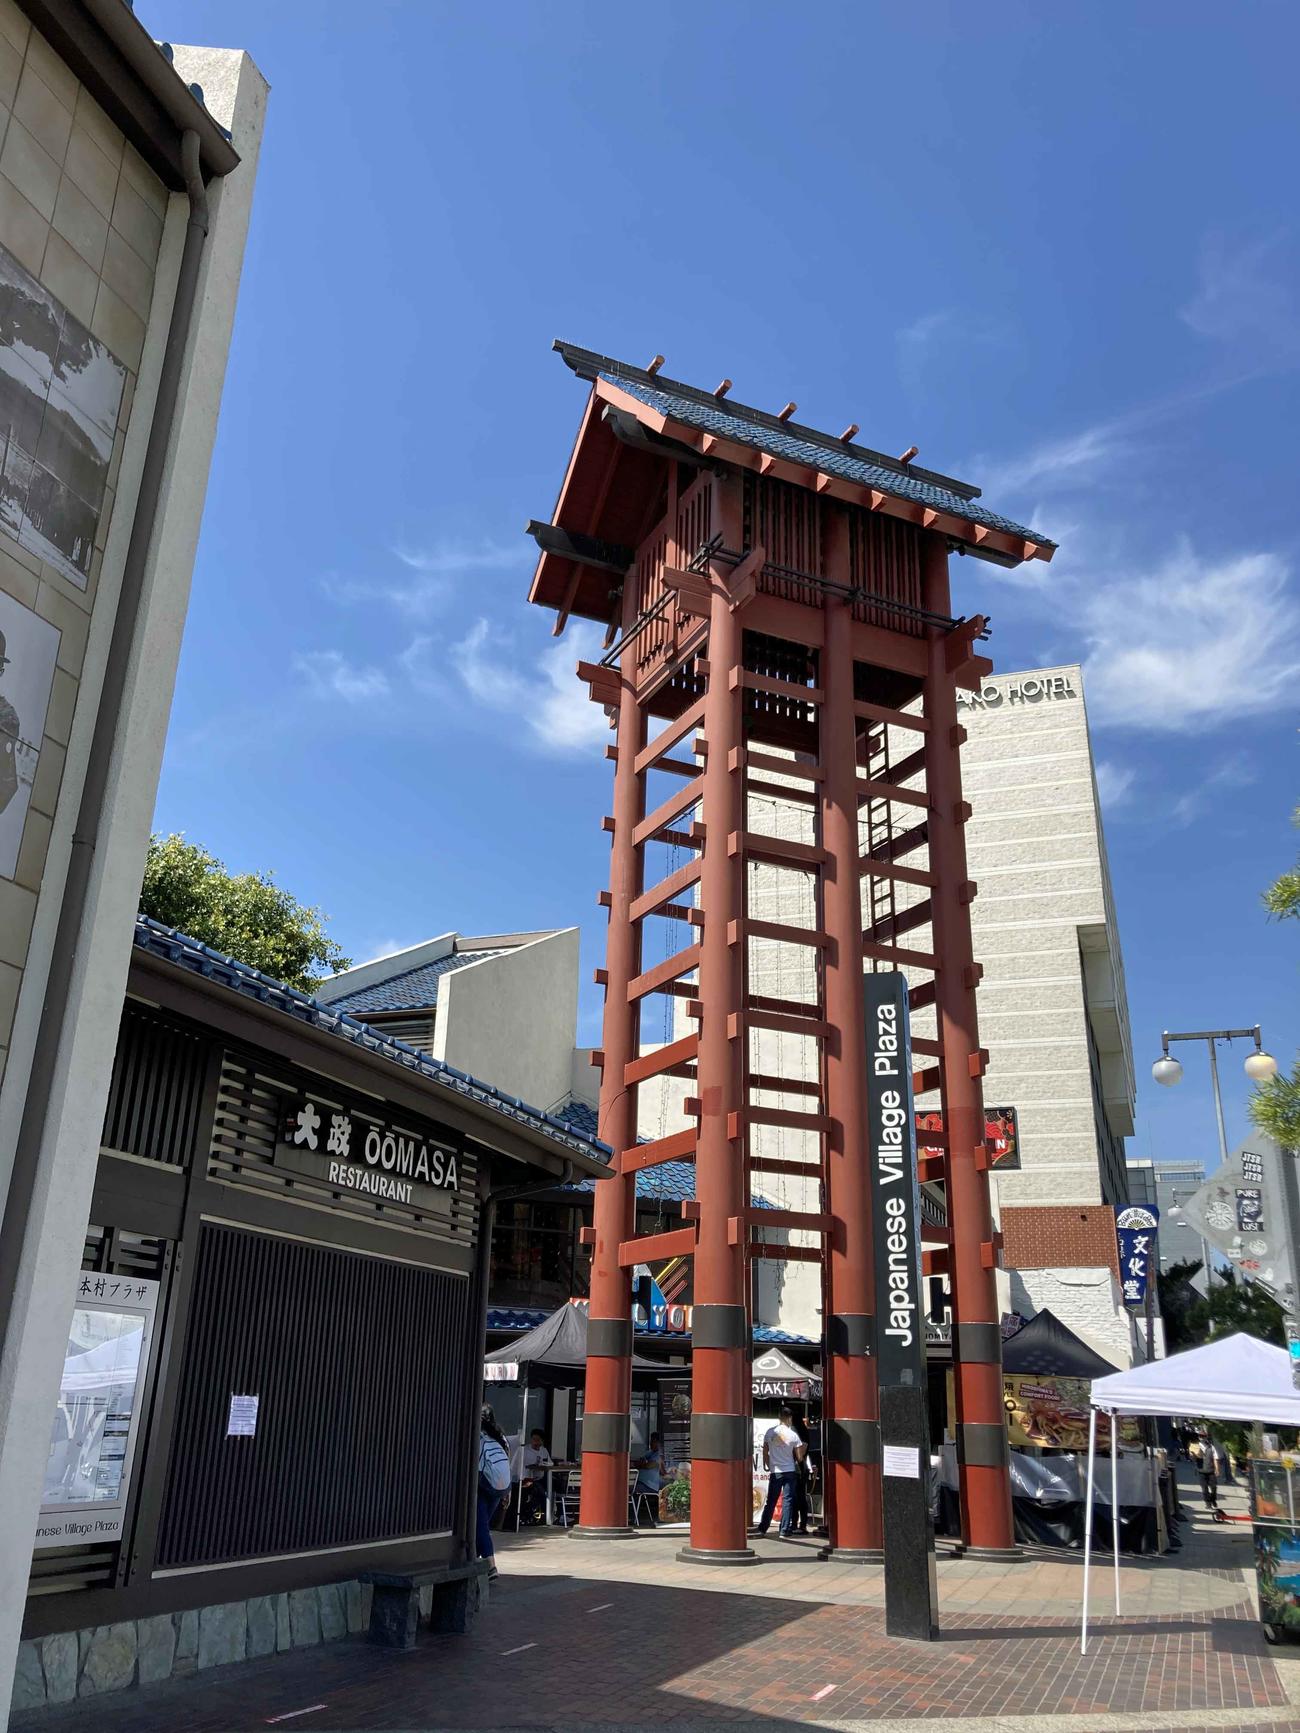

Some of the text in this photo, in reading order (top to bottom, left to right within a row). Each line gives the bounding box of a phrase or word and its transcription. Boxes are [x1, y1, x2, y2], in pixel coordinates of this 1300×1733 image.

[1007, 676, 1074, 698] HOTEL
[329, 1161, 413, 1204] RESTAURANT
[874, 1003, 915, 1346] Japanese Village Plaza
[1123, 1235, 1150, 1300] 文化堂
[65, 1522, 93, 1536] Village
[95, 1520, 119, 1532] Plaza
